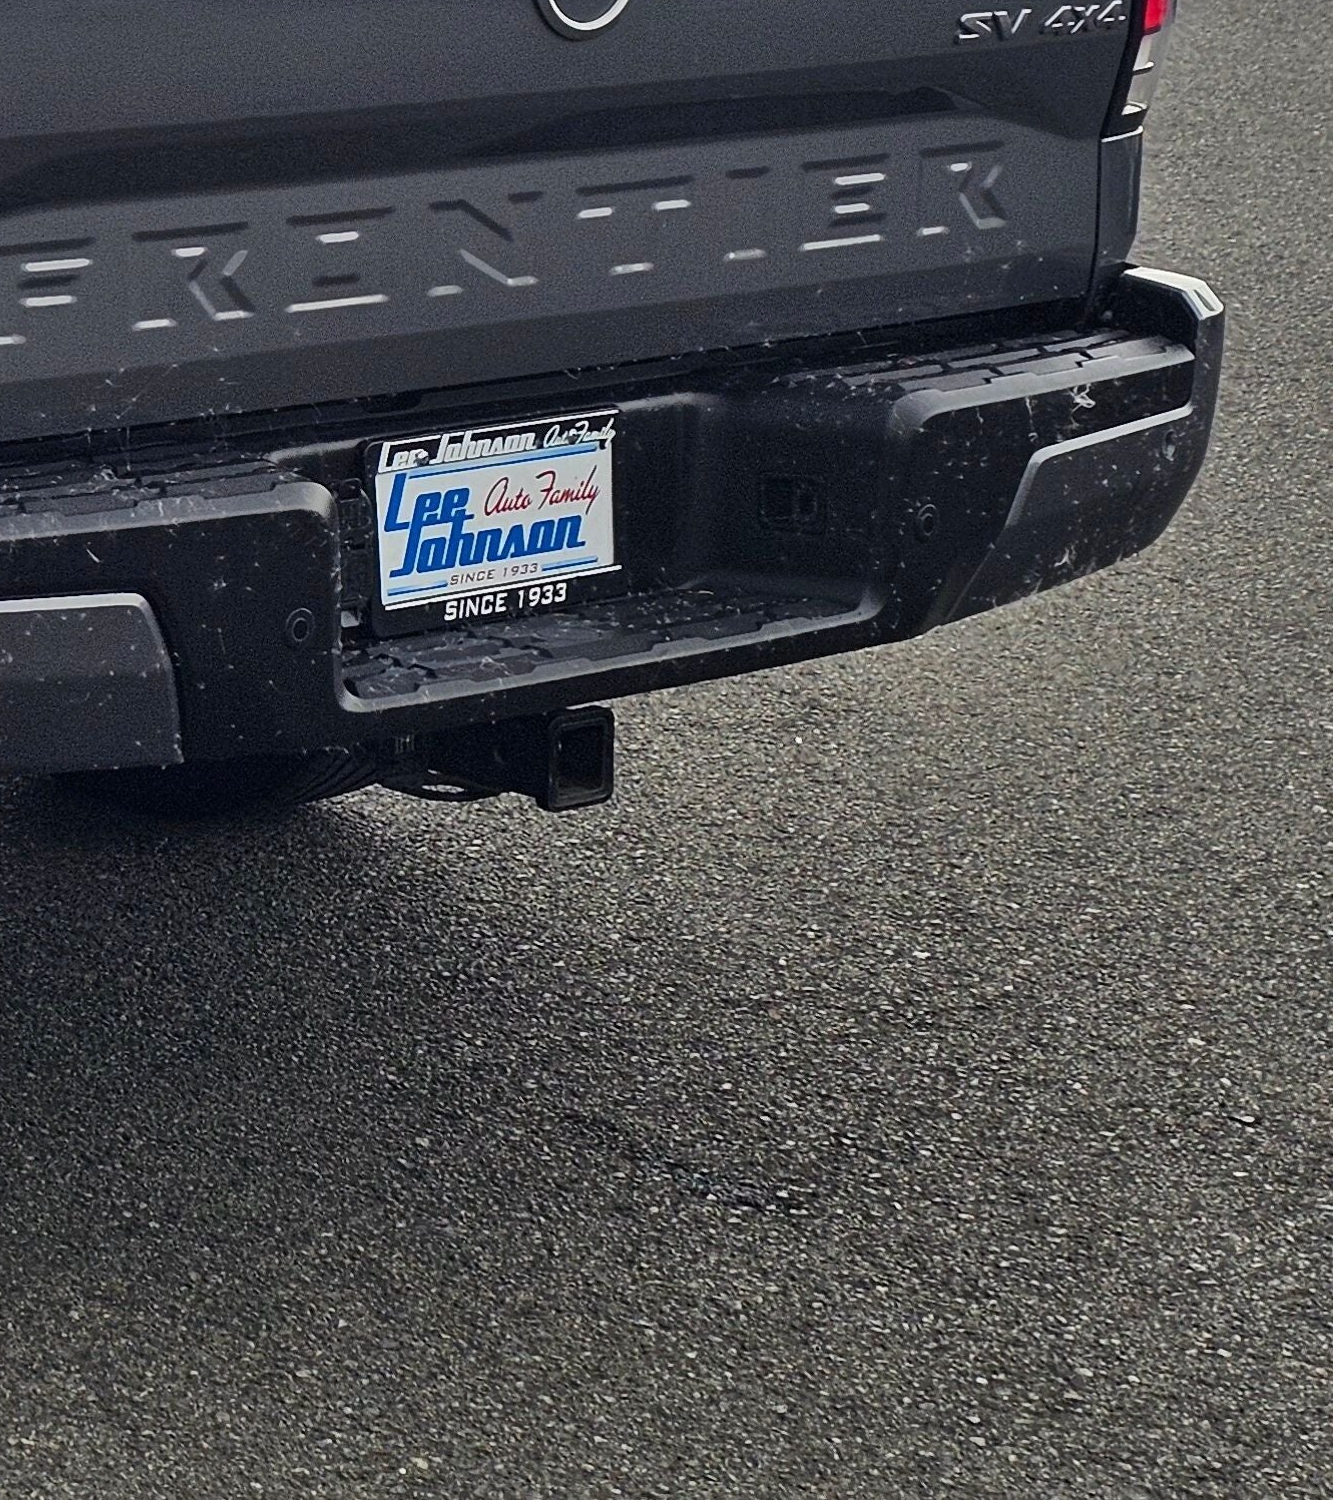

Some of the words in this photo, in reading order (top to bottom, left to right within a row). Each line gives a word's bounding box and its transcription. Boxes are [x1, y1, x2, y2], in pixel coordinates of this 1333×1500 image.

[954, 8, 1032, 42] SV
[429, 431, 537, 465] Johnson
[384, 473, 474, 532] Lee
[484, 476, 533, 516] Auto
[535, 465, 600, 515] Family
[389, 508, 586, 578] Johnson
[450, 568, 496, 586] SINCE
[502, 562, 539, 580] 1933
[443, 592, 509, 621] SINCE
[517, 582, 567, 609] 1933
